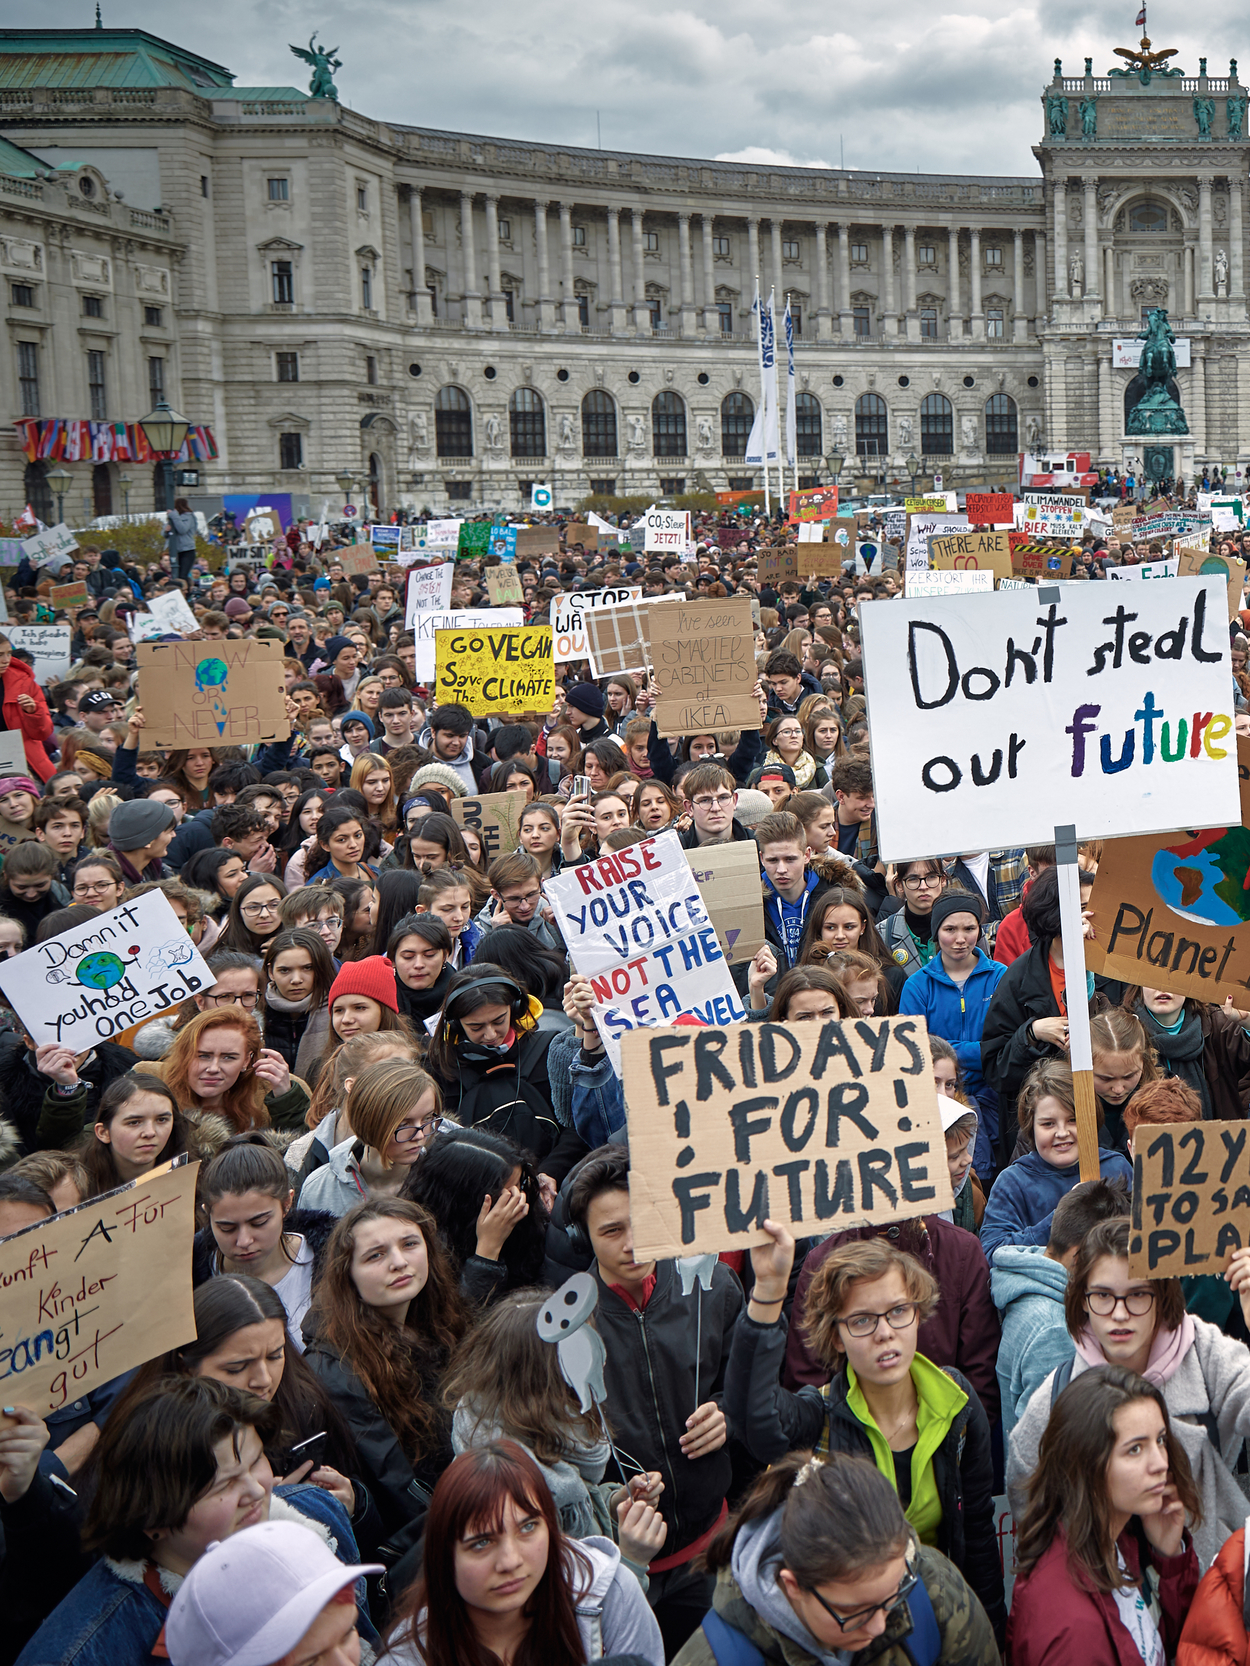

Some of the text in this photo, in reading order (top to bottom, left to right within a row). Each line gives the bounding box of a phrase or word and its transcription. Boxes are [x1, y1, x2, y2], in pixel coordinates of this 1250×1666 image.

[1025, 495, 1085, 508] KLIMAWANDEL
[1041, 505, 1072, 514] STOPPEN
[653, 532, 681, 545] JETZT!
[917, 522, 968, 534] WHY SHOULD
[1024, 521, 1049, 534] BIER
[761, 551, 771, 559] SO
[932, 535, 1004, 558] THERE ARE
[1023, 553, 1044, 561] GAME
[1022, 561, 1043, 569] OVER
[972, 574, 988, 585] IHR
[416, 595, 442, 609] NOT THE
[417, 614, 466, 639] KEINE
[677, 608, 741, 633] I've seen
[450, 636, 484, 654] GO
[662, 635, 744, 665] SMARTER
[907, 588, 1223, 710] Don't steal
[440, 661, 552, 701] Save CLIMATE
[657, 661, 750, 688] CABINETS
[192, 688, 222, 705] OR
[453, 688, 475, 704] The
[696, 684, 716, 703] at
[173, 705, 261, 741] NEVER
[683, 705, 727, 728] IKEA
[921, 690, 1233, 794] our future
[574, 838, 663, 896] RAISE
[567, 880, 654, 934] YOUR
[38, 907, 140, 969] Damn it
[603, 894, 708, 958] VOICE
[1107, 902, 1237, 984] Planet
[590, 927, 723, 1004] NOT THE
[604, 983, 682, 1040] SEA
[649, 1019, 926, 1107] FRIDAYS
[1147, 1127, 1209, 1189] 12
[672, 1142, 936, 1245] FUTURE
[1146, 1191, 1200, 1226] TO
[38, 1273, 118, 1324] Kinder
[50, 1323, 124, 1410] gut
